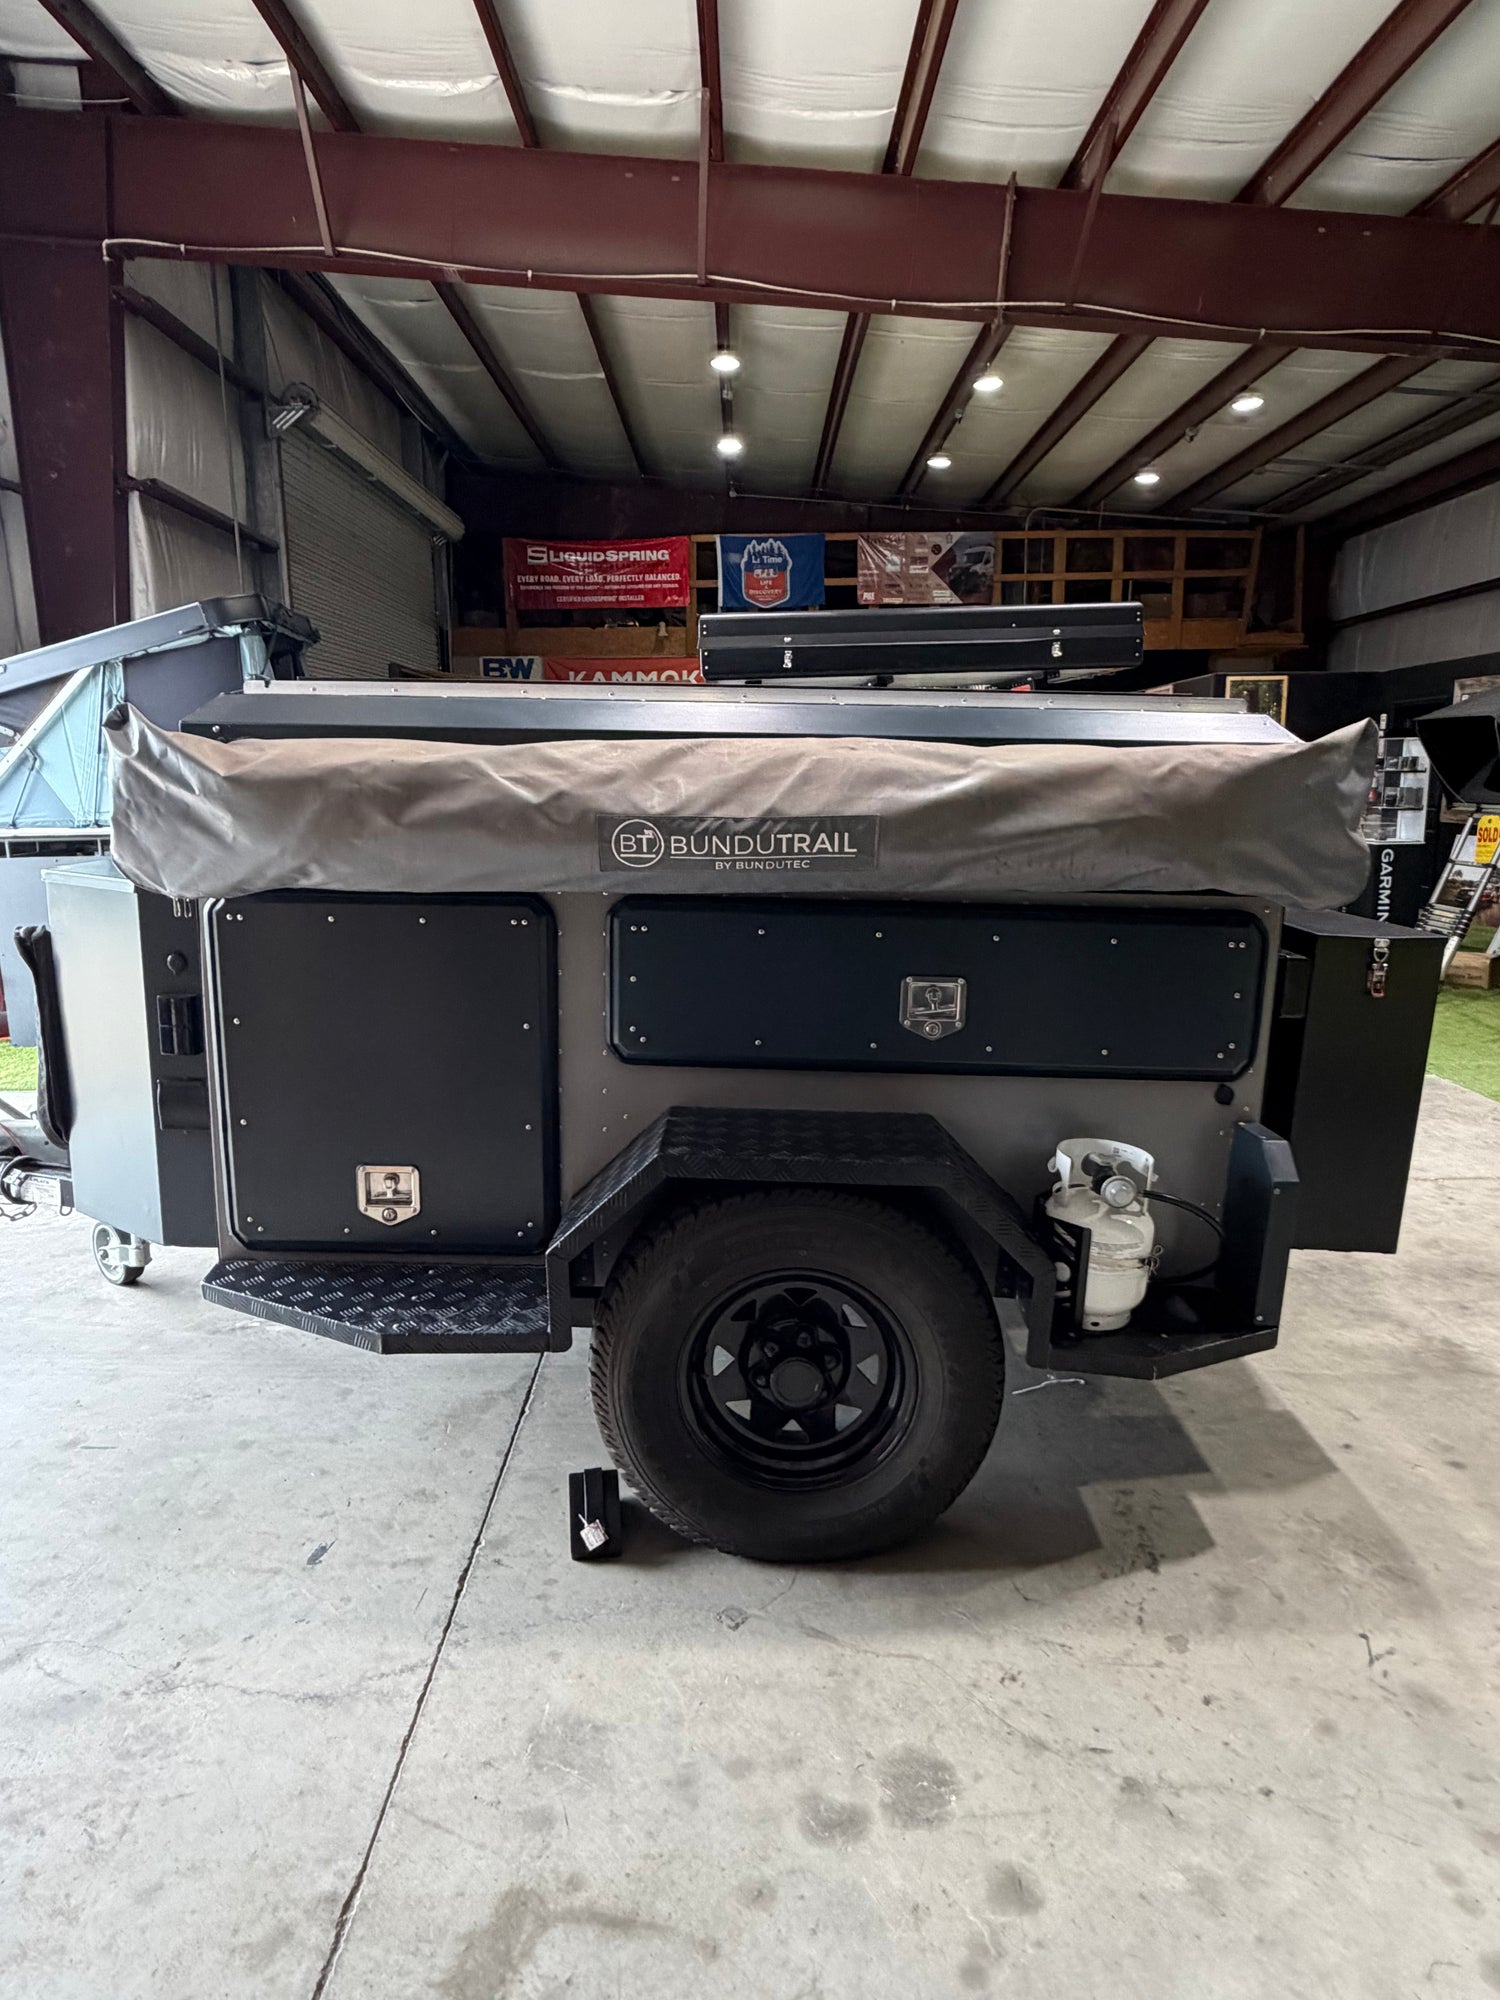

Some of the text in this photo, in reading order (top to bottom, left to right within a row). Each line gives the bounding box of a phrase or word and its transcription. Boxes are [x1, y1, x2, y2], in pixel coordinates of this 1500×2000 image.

[517, 575, 539, 583] EVERY
[540, 575, 562, 583] ROAD.
[562, 575, 584, 583] EVERY
[606, 573, 644, 583] PERFECTLY
[645, 573, 682, 582] BALANCED.
[1477, 826, 1499, 843] SOLD
[670, 832, 858, 855] BUNDUTRAIL
[715, 860, 811, 871] BY BUNDUTEC
[1377, 848, 1394, 921] GARMIN
